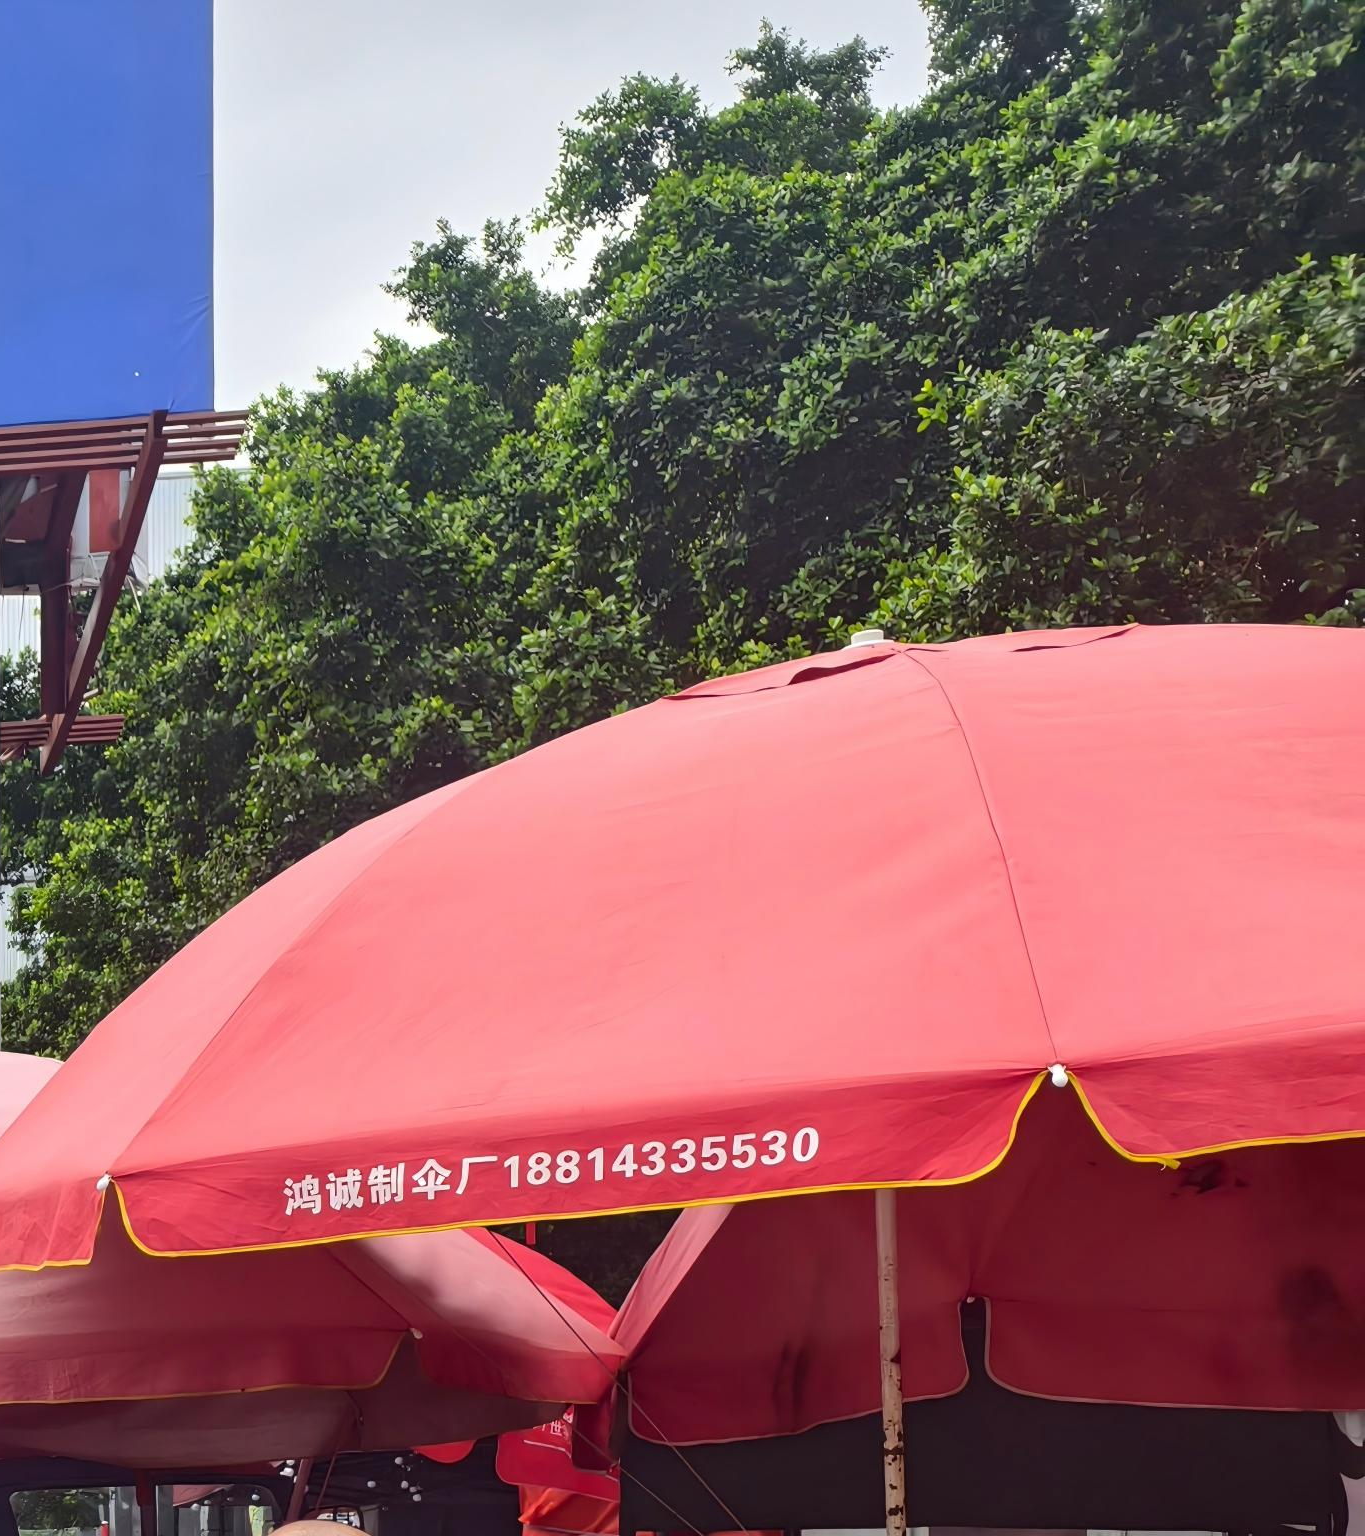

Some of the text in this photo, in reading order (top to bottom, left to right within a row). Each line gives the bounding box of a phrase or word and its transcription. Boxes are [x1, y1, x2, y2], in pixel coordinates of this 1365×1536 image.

[284, 1126, 820, 1216] 鸿诚制伞厂18814335530
